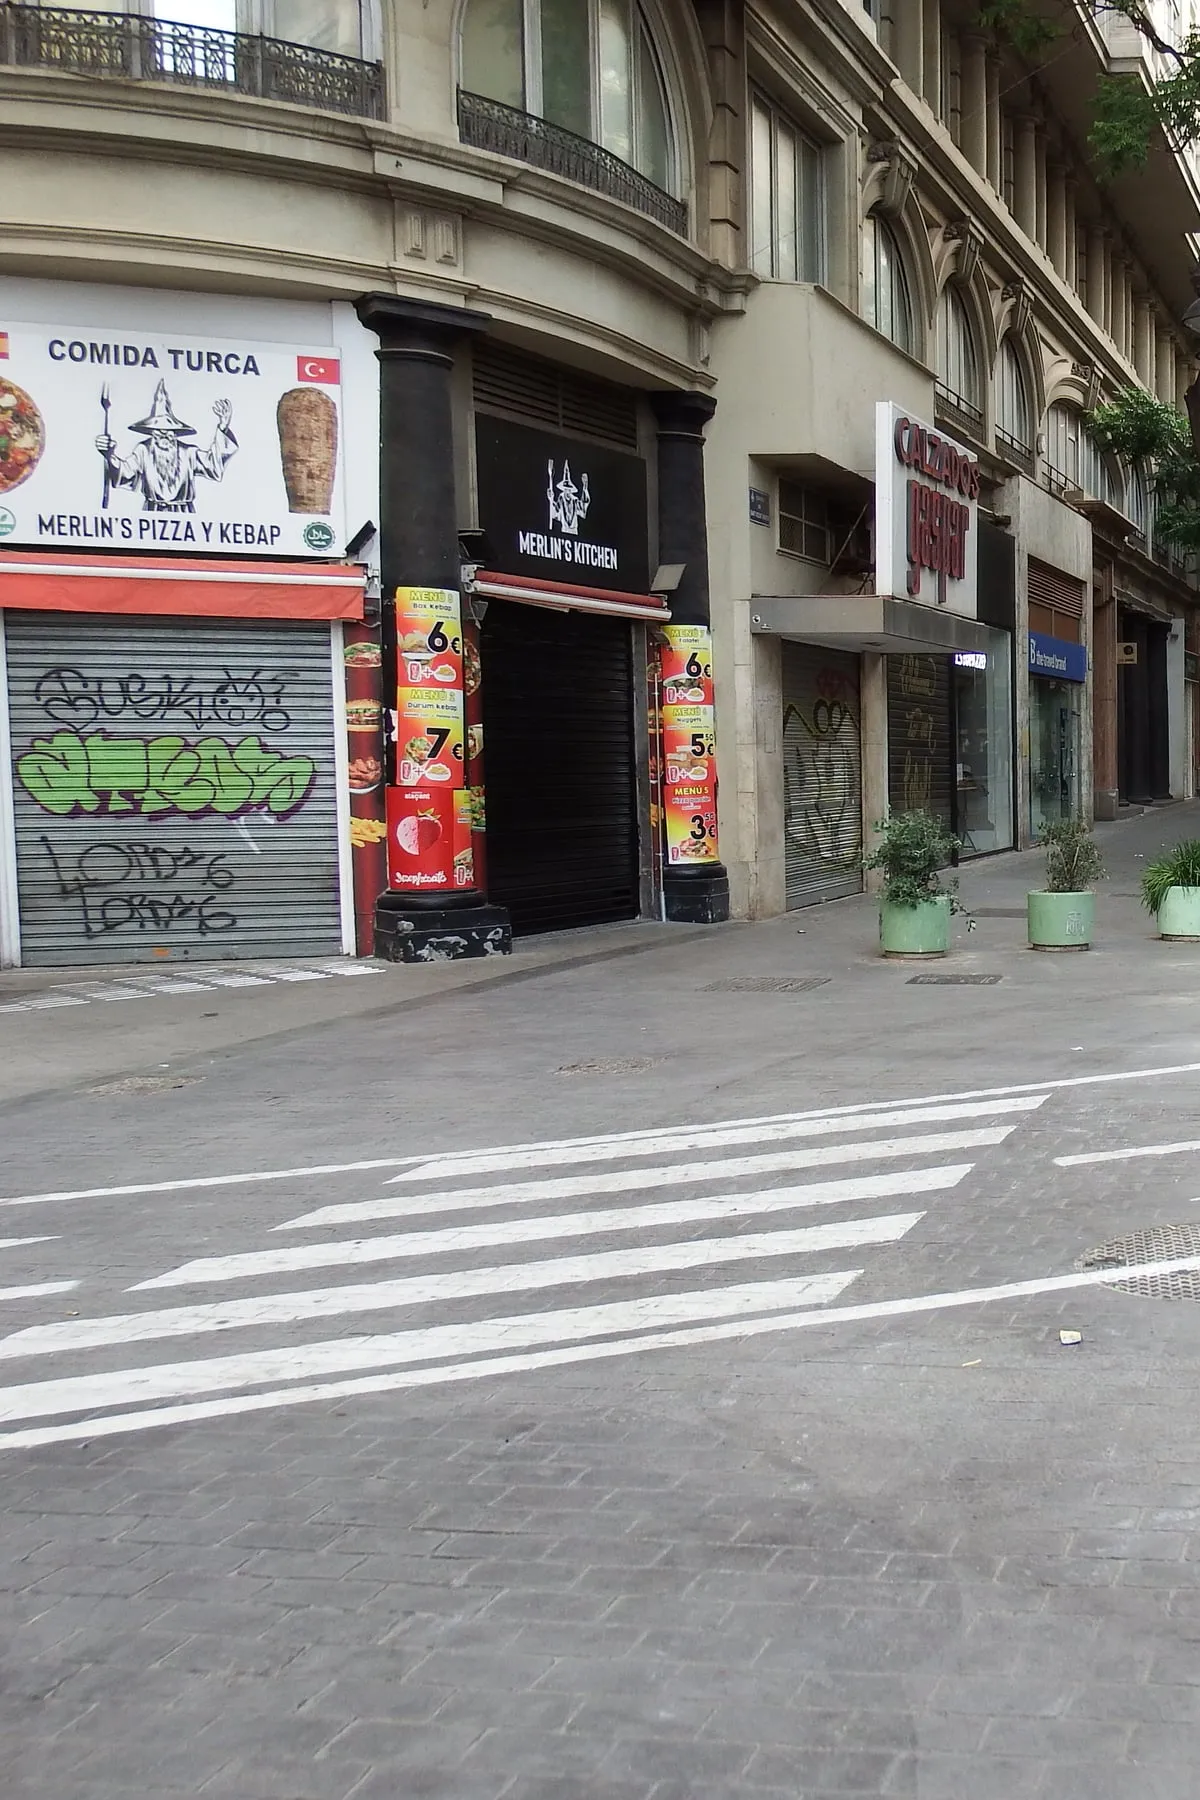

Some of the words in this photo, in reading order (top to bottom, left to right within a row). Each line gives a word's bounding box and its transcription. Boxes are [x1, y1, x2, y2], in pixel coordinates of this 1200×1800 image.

[49, 339, 159, 369] COMIDA
[167, 348, 260, 376] TURCA
[894, 417, 981, 500] CALZADOS
[38, 513, 132, 540] MERLIN'S
[139, 518, 195, 544] PIZZA
[201, 521, 213, 544] Y
[219, 523, 281, 546] KEBAP
[519, 530, 572, 562] MERLIN'S
[574, 541, 618, 570] KITCHEN
